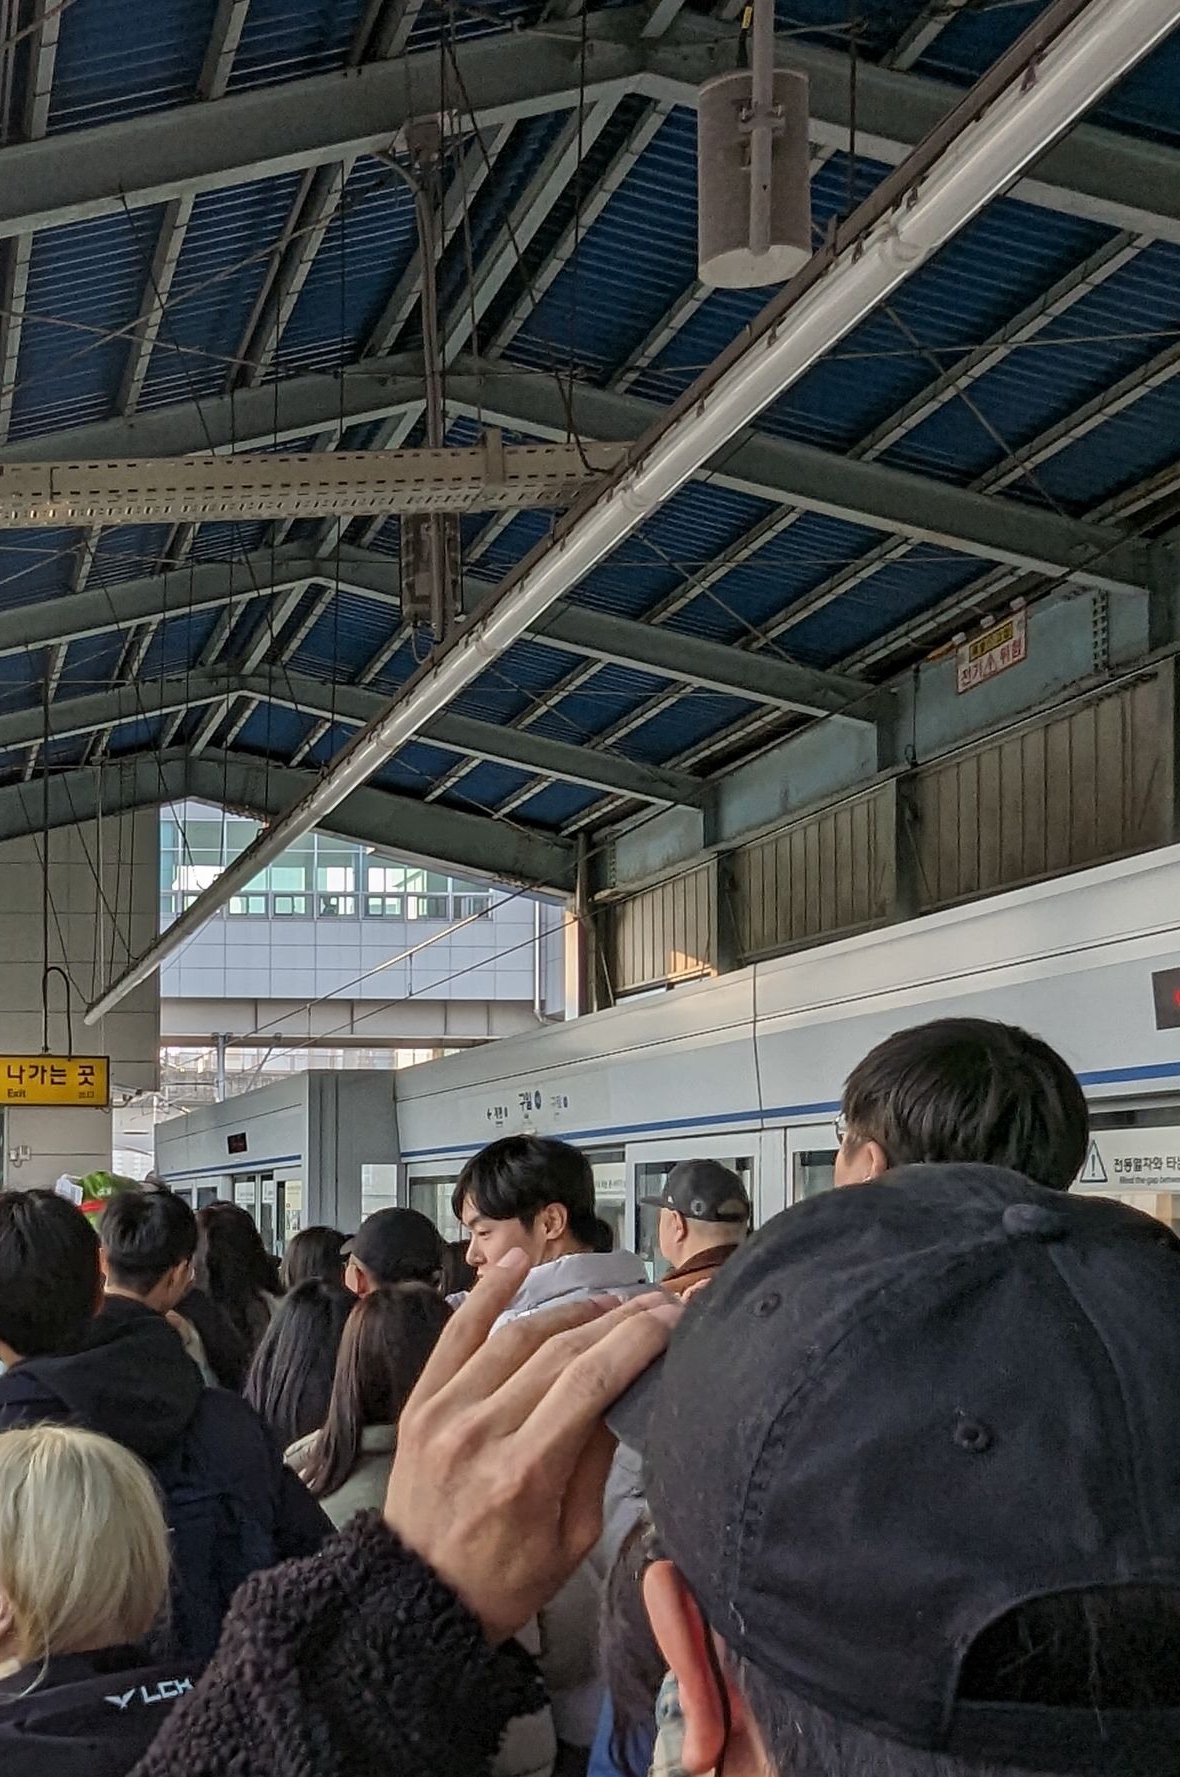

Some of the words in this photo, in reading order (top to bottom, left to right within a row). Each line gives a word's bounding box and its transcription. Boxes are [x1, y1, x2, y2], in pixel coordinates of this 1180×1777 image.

[6, 1064, 67, 1086] 나가는
[77, 1064, 96, 1087] 곳
[7, 1088, 26, 1099] Exit
[140, 1678, 194, 1704] LCK
